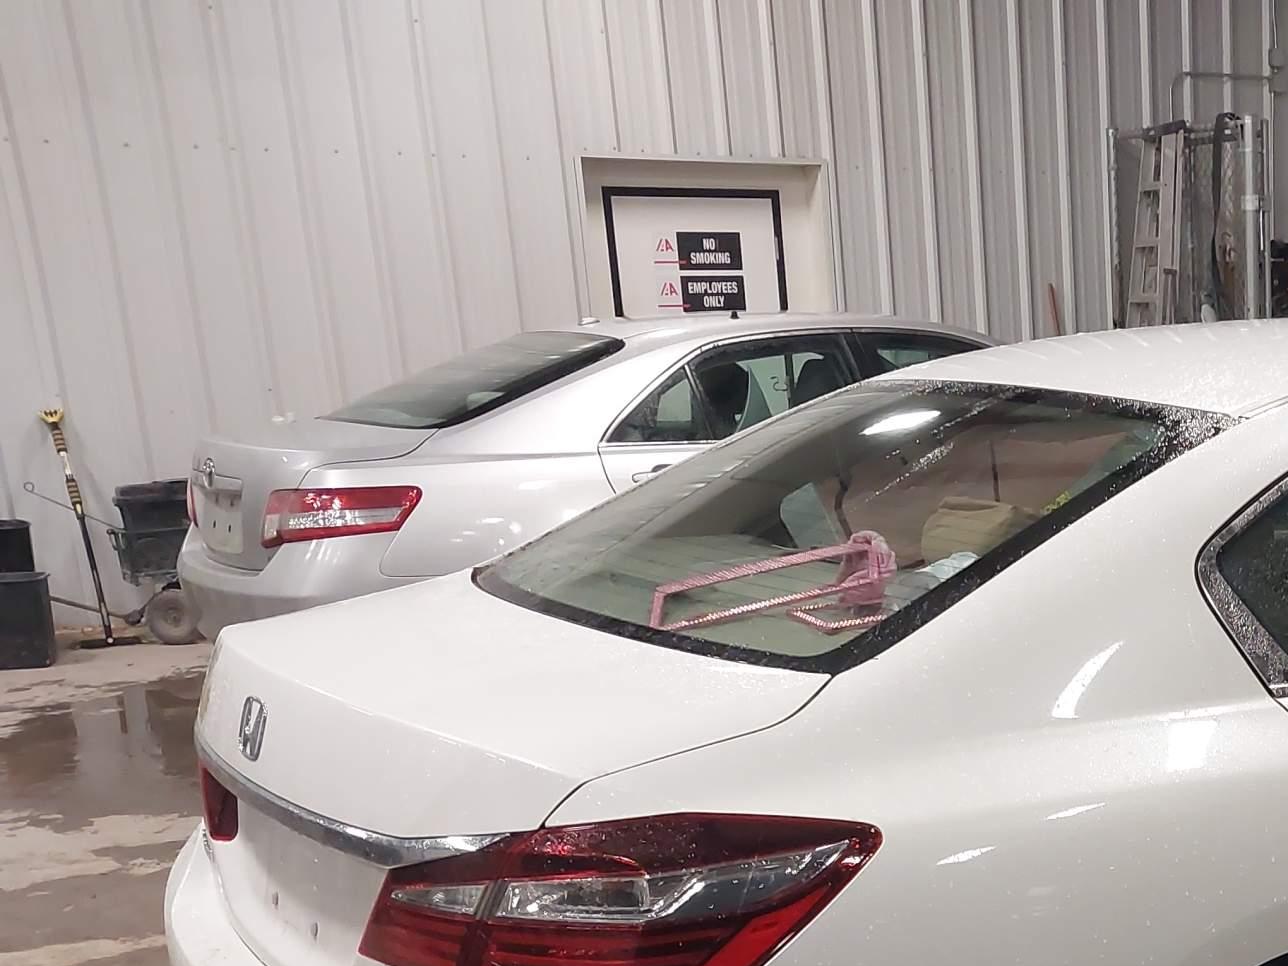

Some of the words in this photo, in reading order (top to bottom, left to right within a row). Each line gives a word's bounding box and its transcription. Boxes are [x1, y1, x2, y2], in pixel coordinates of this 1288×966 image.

[702, 238, 715, 251] NO
[690, 252, 731, 265] SMOKING
[687, 281, 738, 294] EMPLOYEES
[703, 295, 724, 308] ONLY
